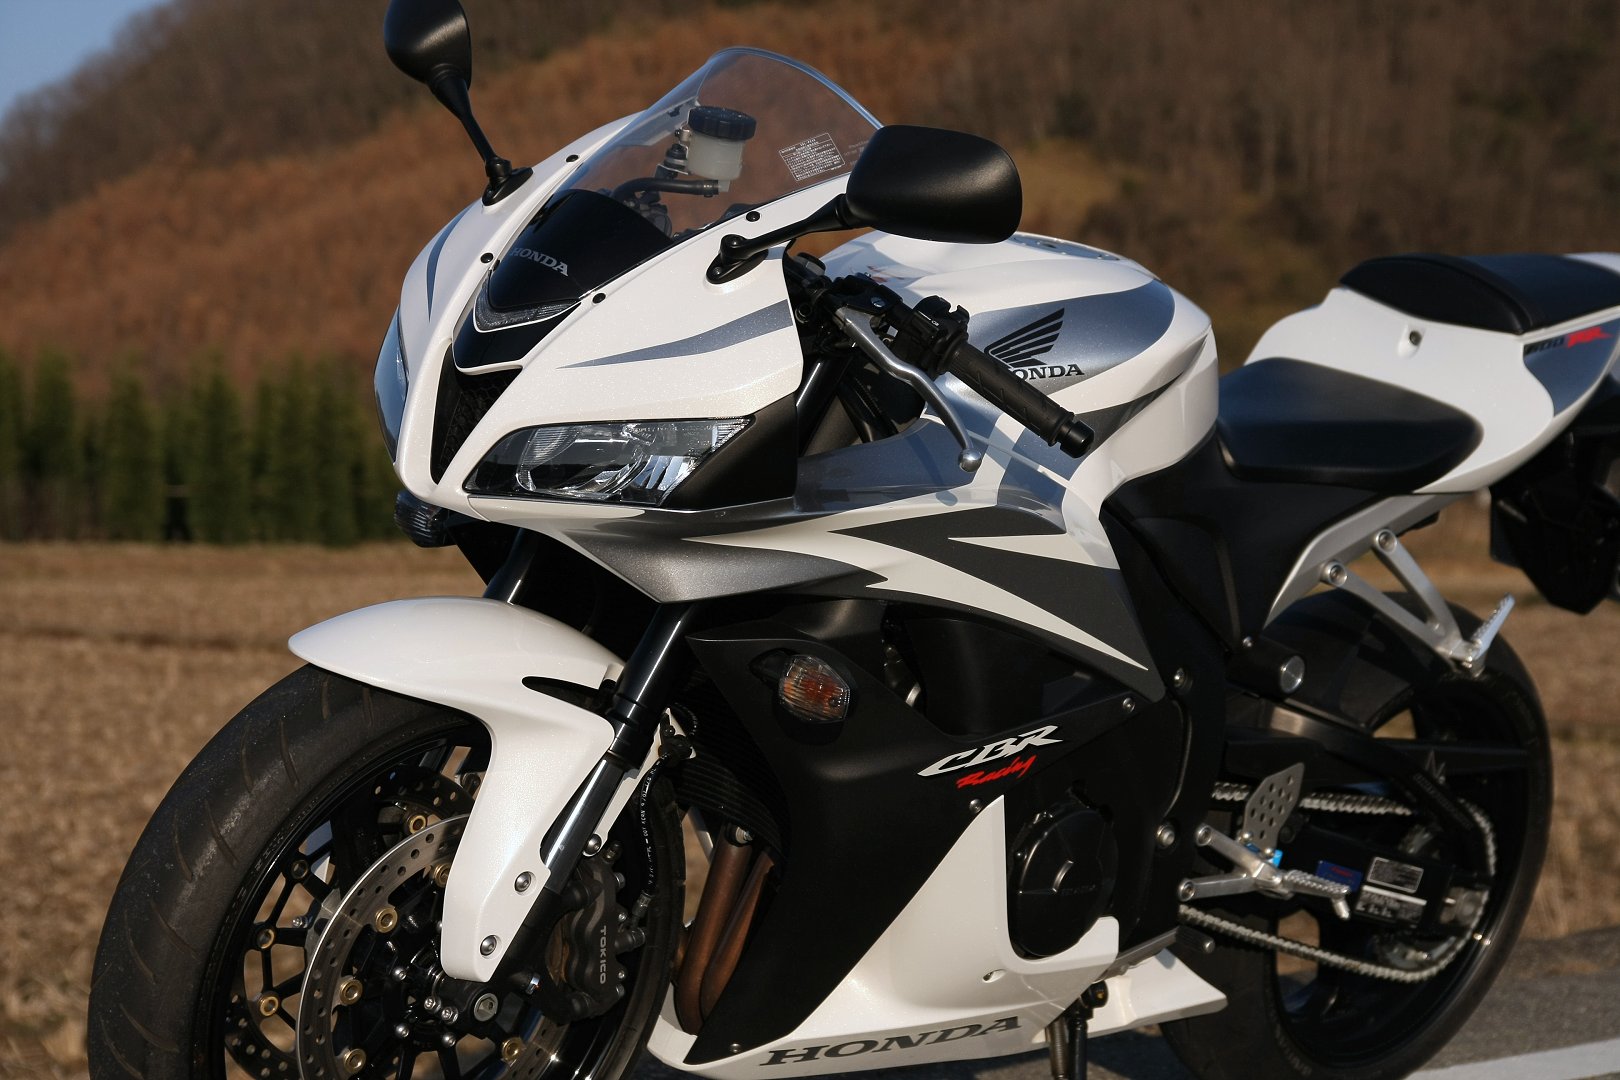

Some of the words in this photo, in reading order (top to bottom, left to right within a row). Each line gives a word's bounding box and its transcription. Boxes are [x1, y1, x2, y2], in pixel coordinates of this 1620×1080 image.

[509, 247, 569, 277] HONDA
[1011, 363, 1085, 381] ONDA
[916, 724, 1064, 777] CBR
[956, 755, 1037, 788] Racing
[758, 1015, 1022, 1067] HONDA
